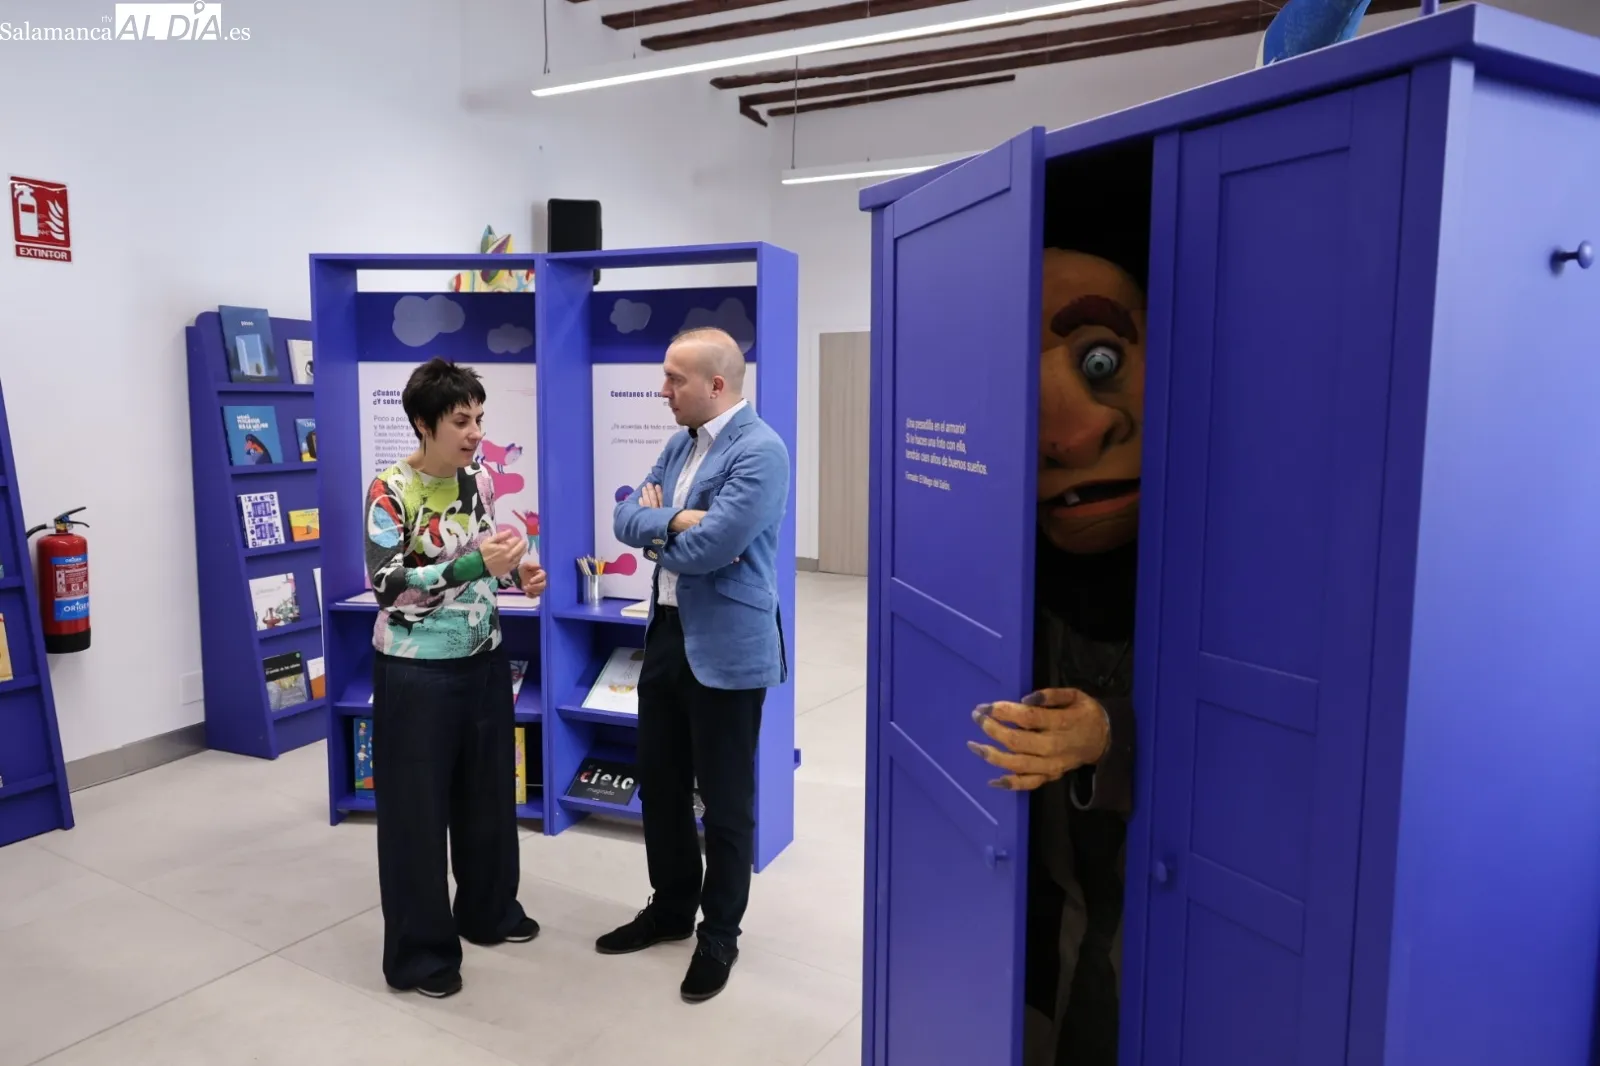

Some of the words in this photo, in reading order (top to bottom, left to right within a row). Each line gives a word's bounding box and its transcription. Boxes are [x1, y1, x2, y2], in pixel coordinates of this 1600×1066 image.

[19, 247, 68, 260] EXTINTOR
[372, 389, 401, 397] ¿Cuánto
[610, 390, 644, 398] Cuéntanos
[646, 390, 653, 398] el
